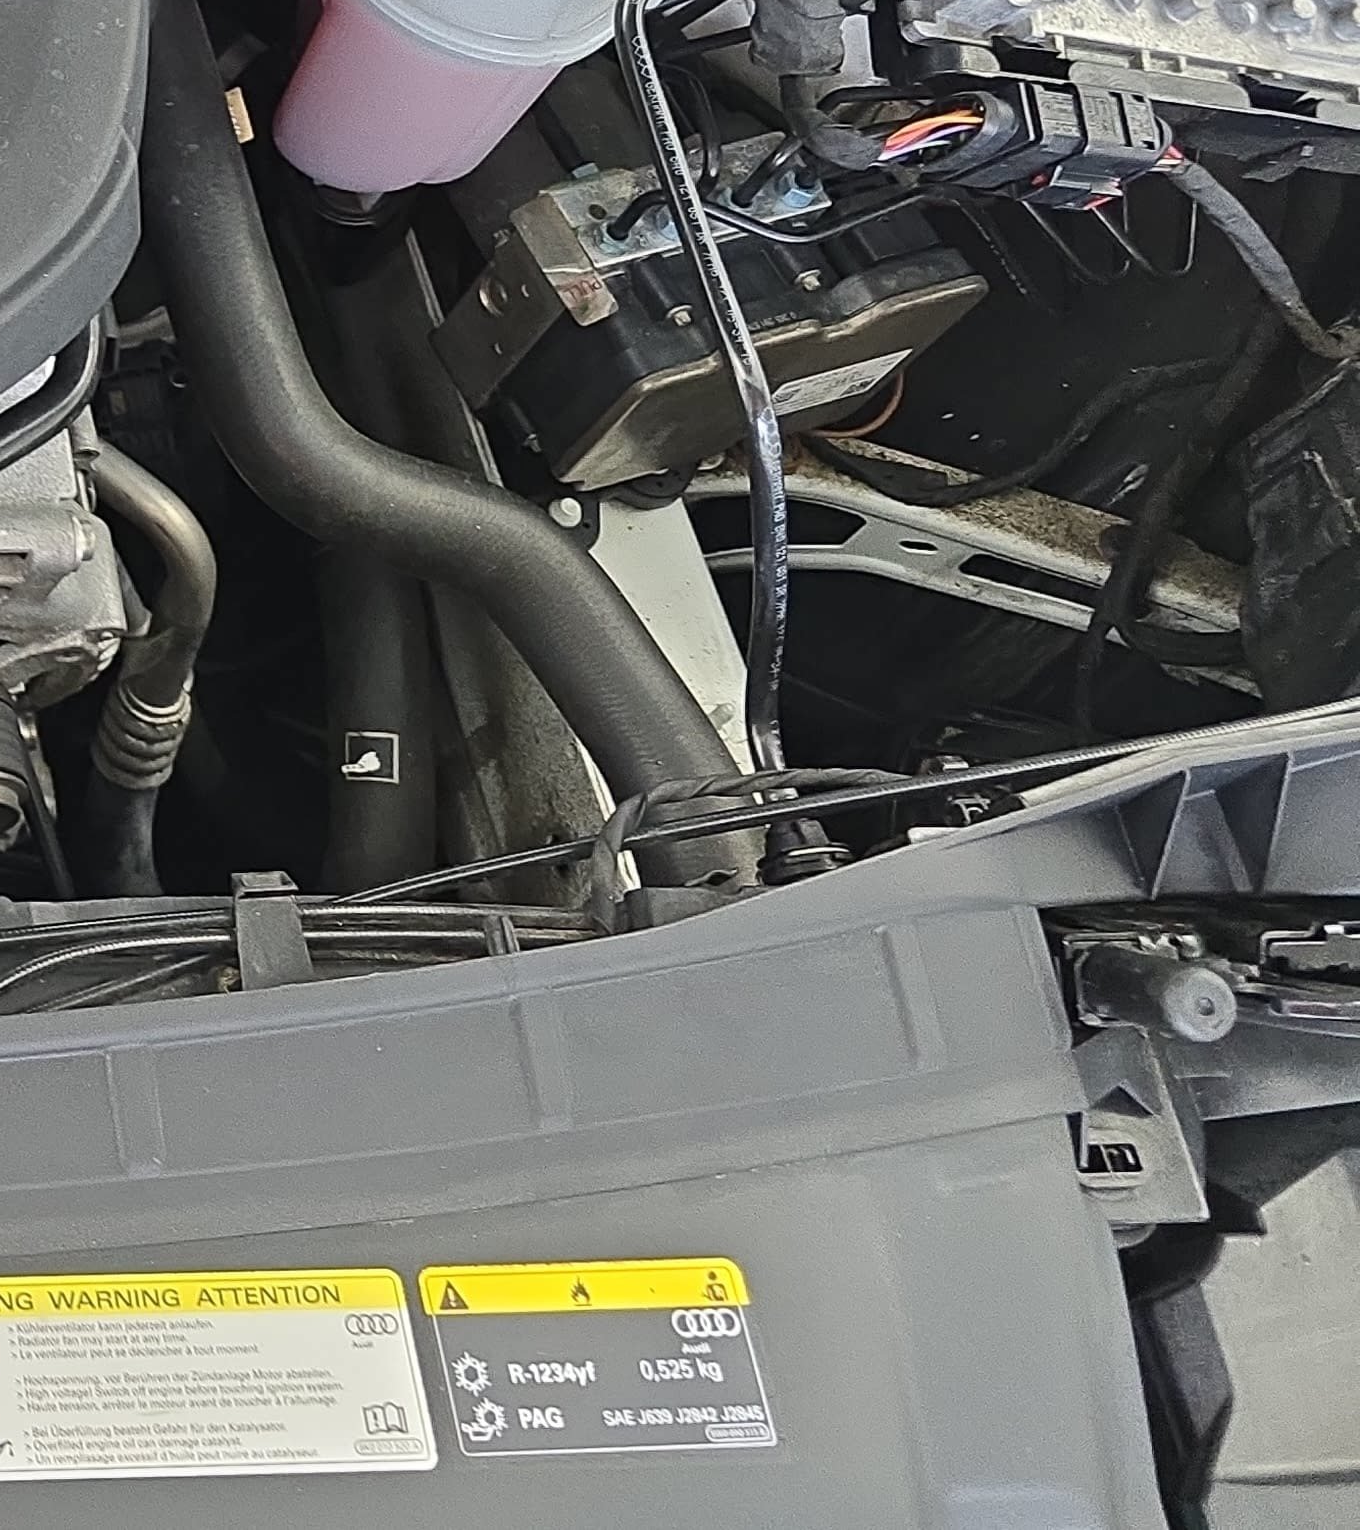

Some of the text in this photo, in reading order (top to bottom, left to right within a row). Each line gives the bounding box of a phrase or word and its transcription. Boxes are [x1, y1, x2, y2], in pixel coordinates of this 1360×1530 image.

[47, 1289, 180, 1310] WARNING
[194, 1285, 341, 1306] ATTENTION
[680, 1341, 712, 1354] Audi
[506, 1356, 725, 1388] R-1234yf 0,525 kg
[516, 1404, 766, 1429] PAG SAE J639 J2842 J2845
